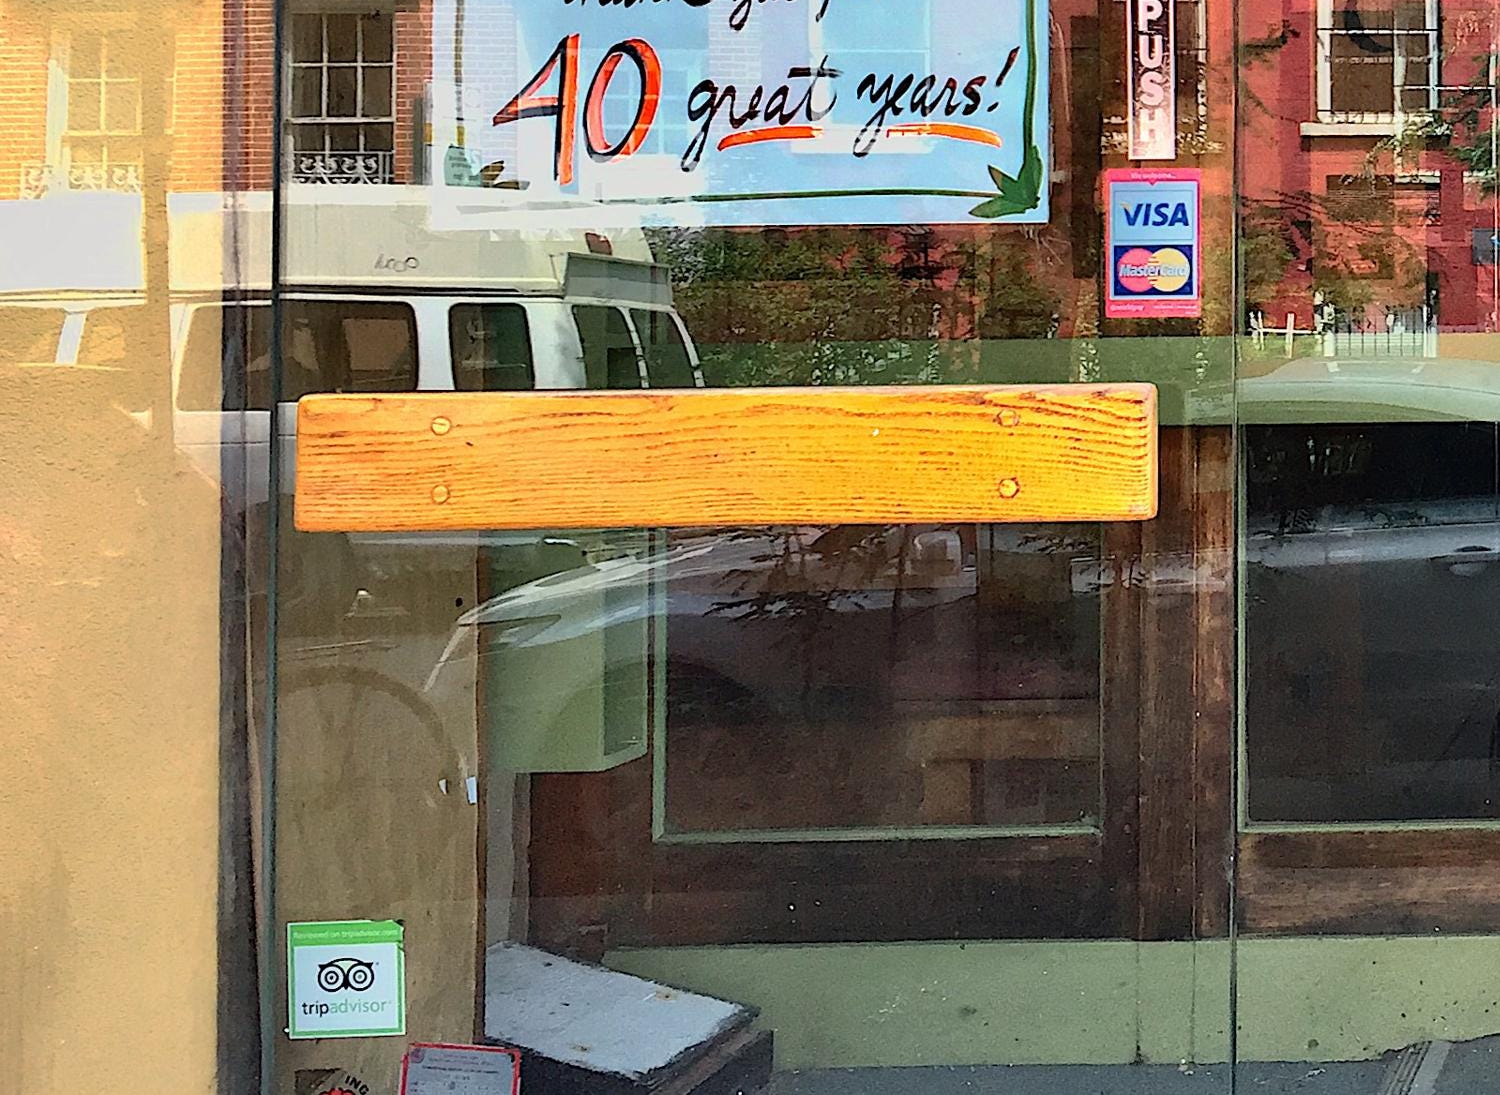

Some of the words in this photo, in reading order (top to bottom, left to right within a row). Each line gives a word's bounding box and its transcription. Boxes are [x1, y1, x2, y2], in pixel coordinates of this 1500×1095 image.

[492, 32, 662, 186] 40
[680, 57, 843, 173] great
[853, 45, 1021, 159] years!
[1121, 201, 1190, 227] VISA
[1118, 263, 1189, 277] MasterCard
[301, 998, 387, 1017] tripadvisor
